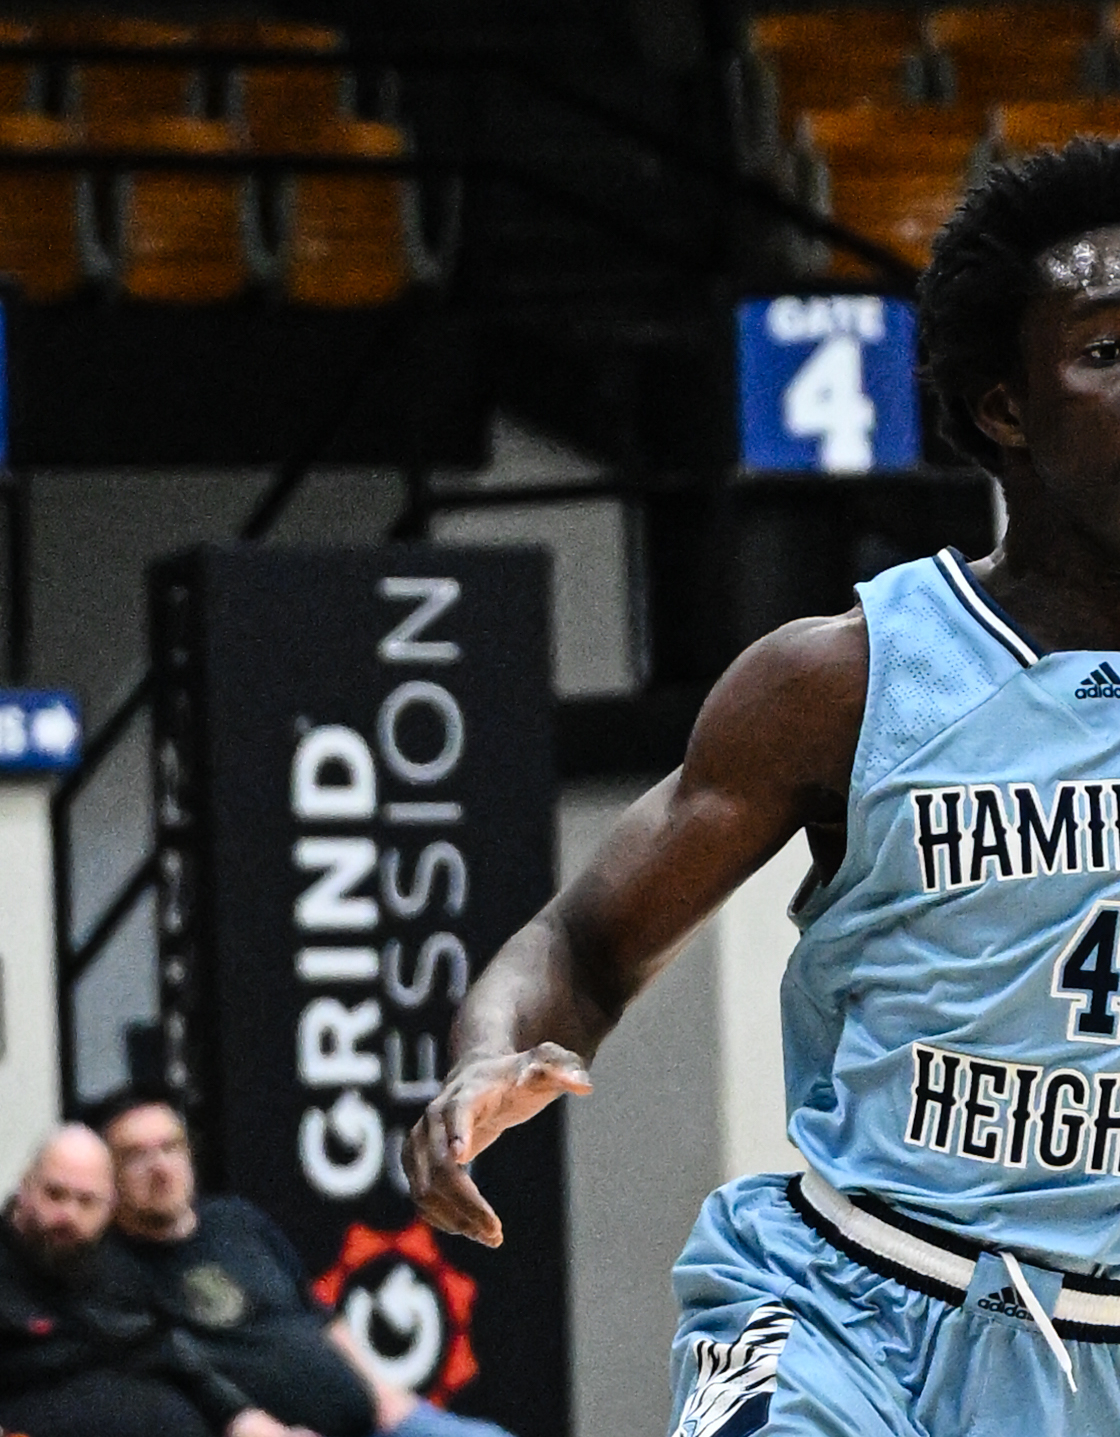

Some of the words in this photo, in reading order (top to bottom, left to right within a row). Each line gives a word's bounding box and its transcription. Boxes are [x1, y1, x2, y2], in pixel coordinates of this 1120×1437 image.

[766, 294, 885, 344] GATE
[781, 336, 877, 475] 4
[291, 723, 385, 1197] GRIND
[378, 576, 468, 1196] ESSION
